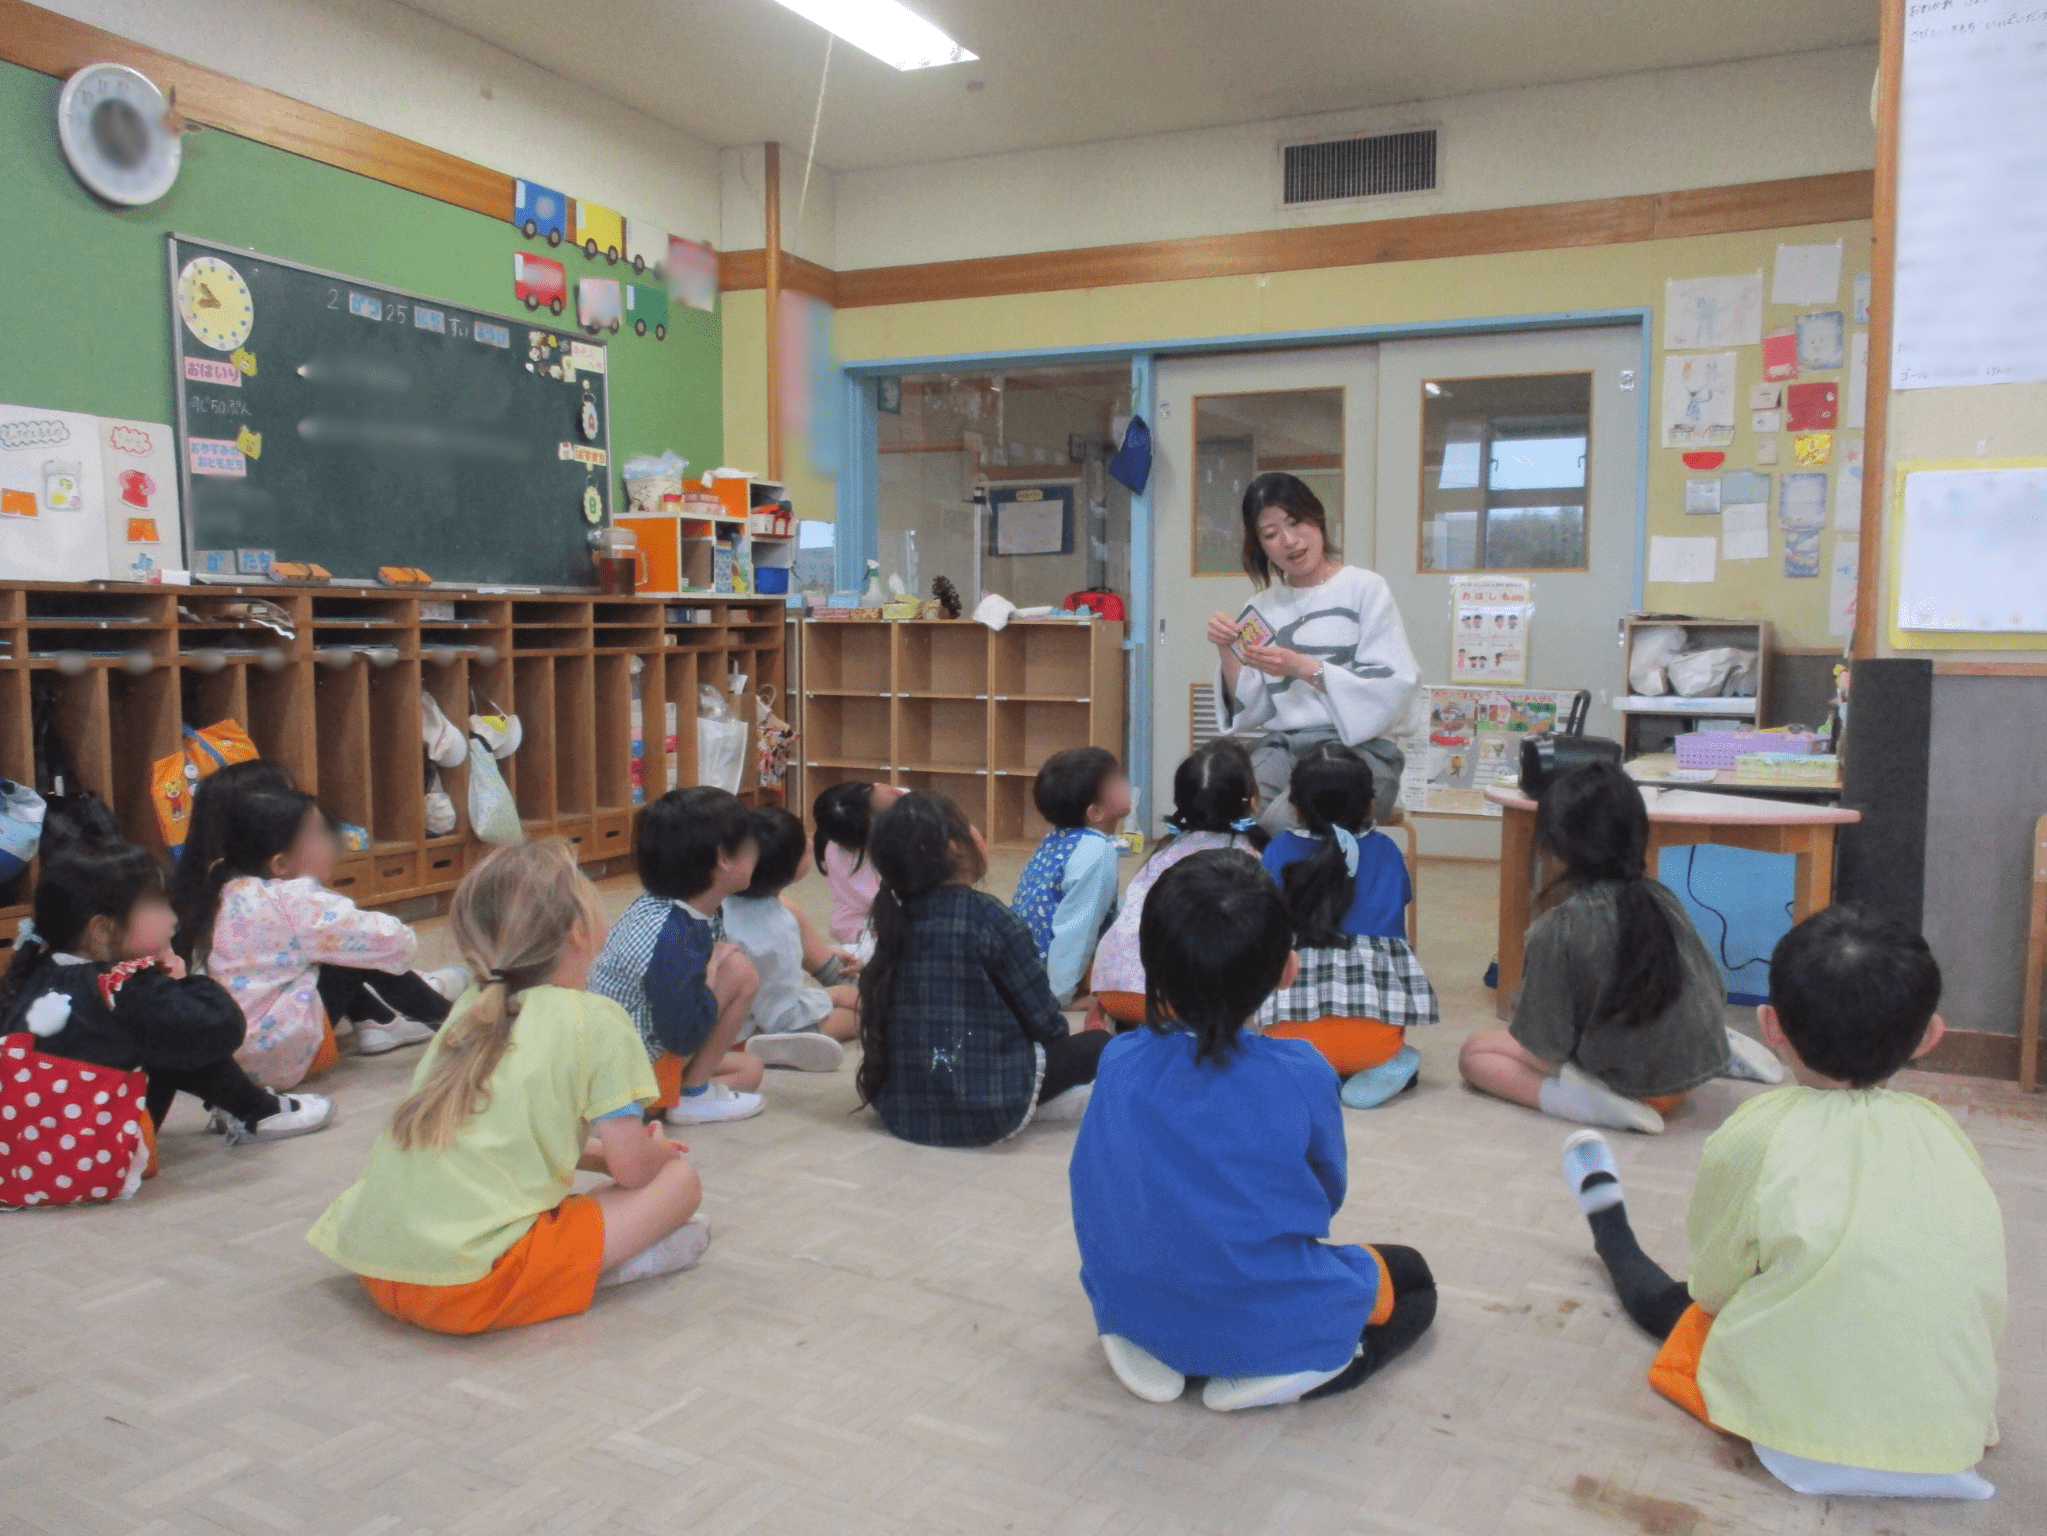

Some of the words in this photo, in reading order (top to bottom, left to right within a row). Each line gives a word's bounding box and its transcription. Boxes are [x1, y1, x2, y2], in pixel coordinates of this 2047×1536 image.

[327, 288, 339, 310] 2
[351, 294, 382, 317] がつ
[386, 304, 408, 324] 25
[416, 312, 441, 329] にち
[187, 362, 239, 382] おはいり
[574, 447, 606, 464] ばすまち
